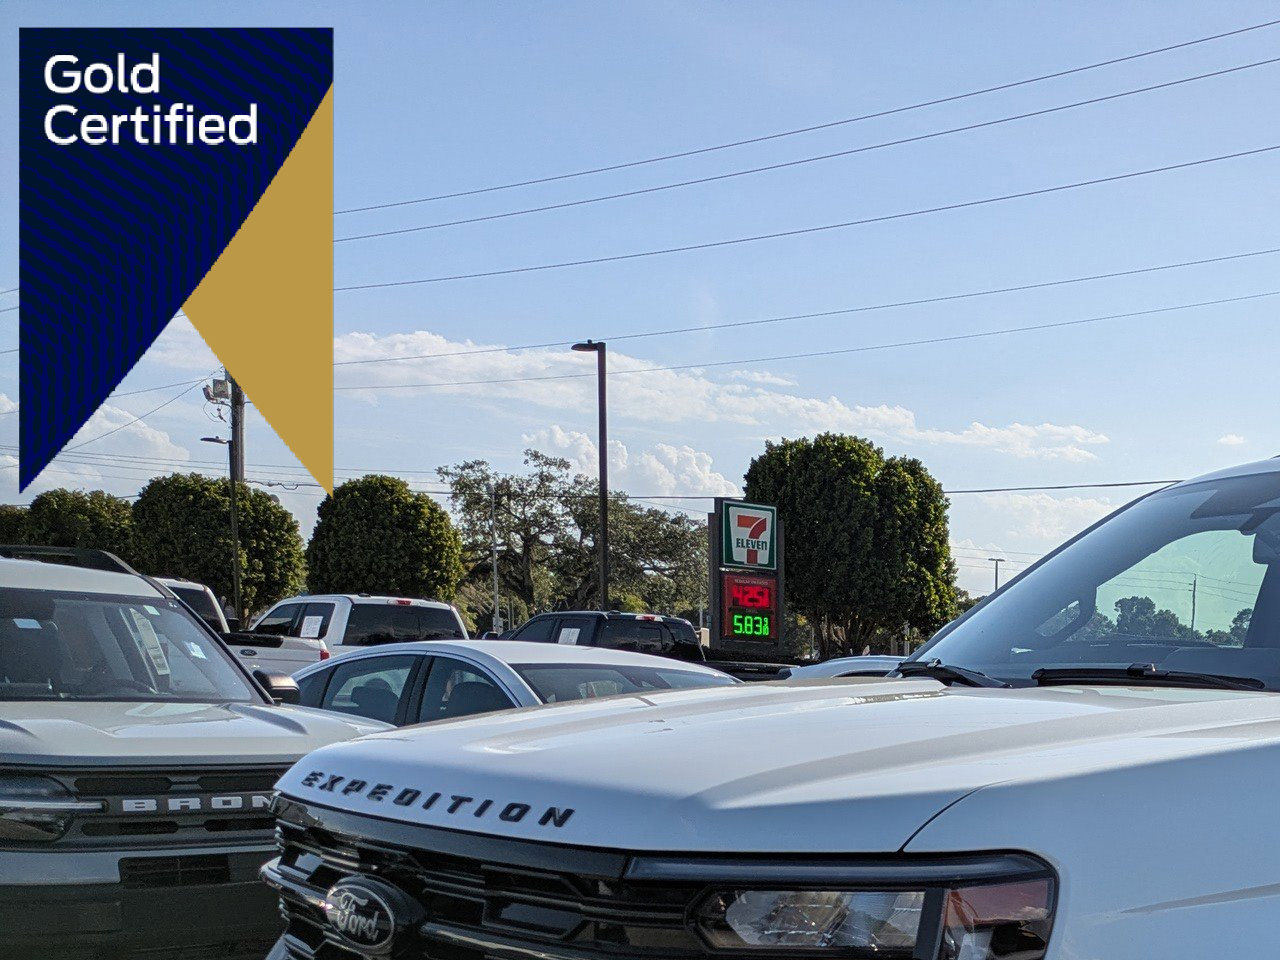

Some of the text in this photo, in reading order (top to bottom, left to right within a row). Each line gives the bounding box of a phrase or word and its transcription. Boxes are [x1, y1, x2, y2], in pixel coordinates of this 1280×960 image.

[737, 514, 767, 565] 7
[301, 770, 576, 829] EXPEDITION
[337, 889, 380, 941] Ford
